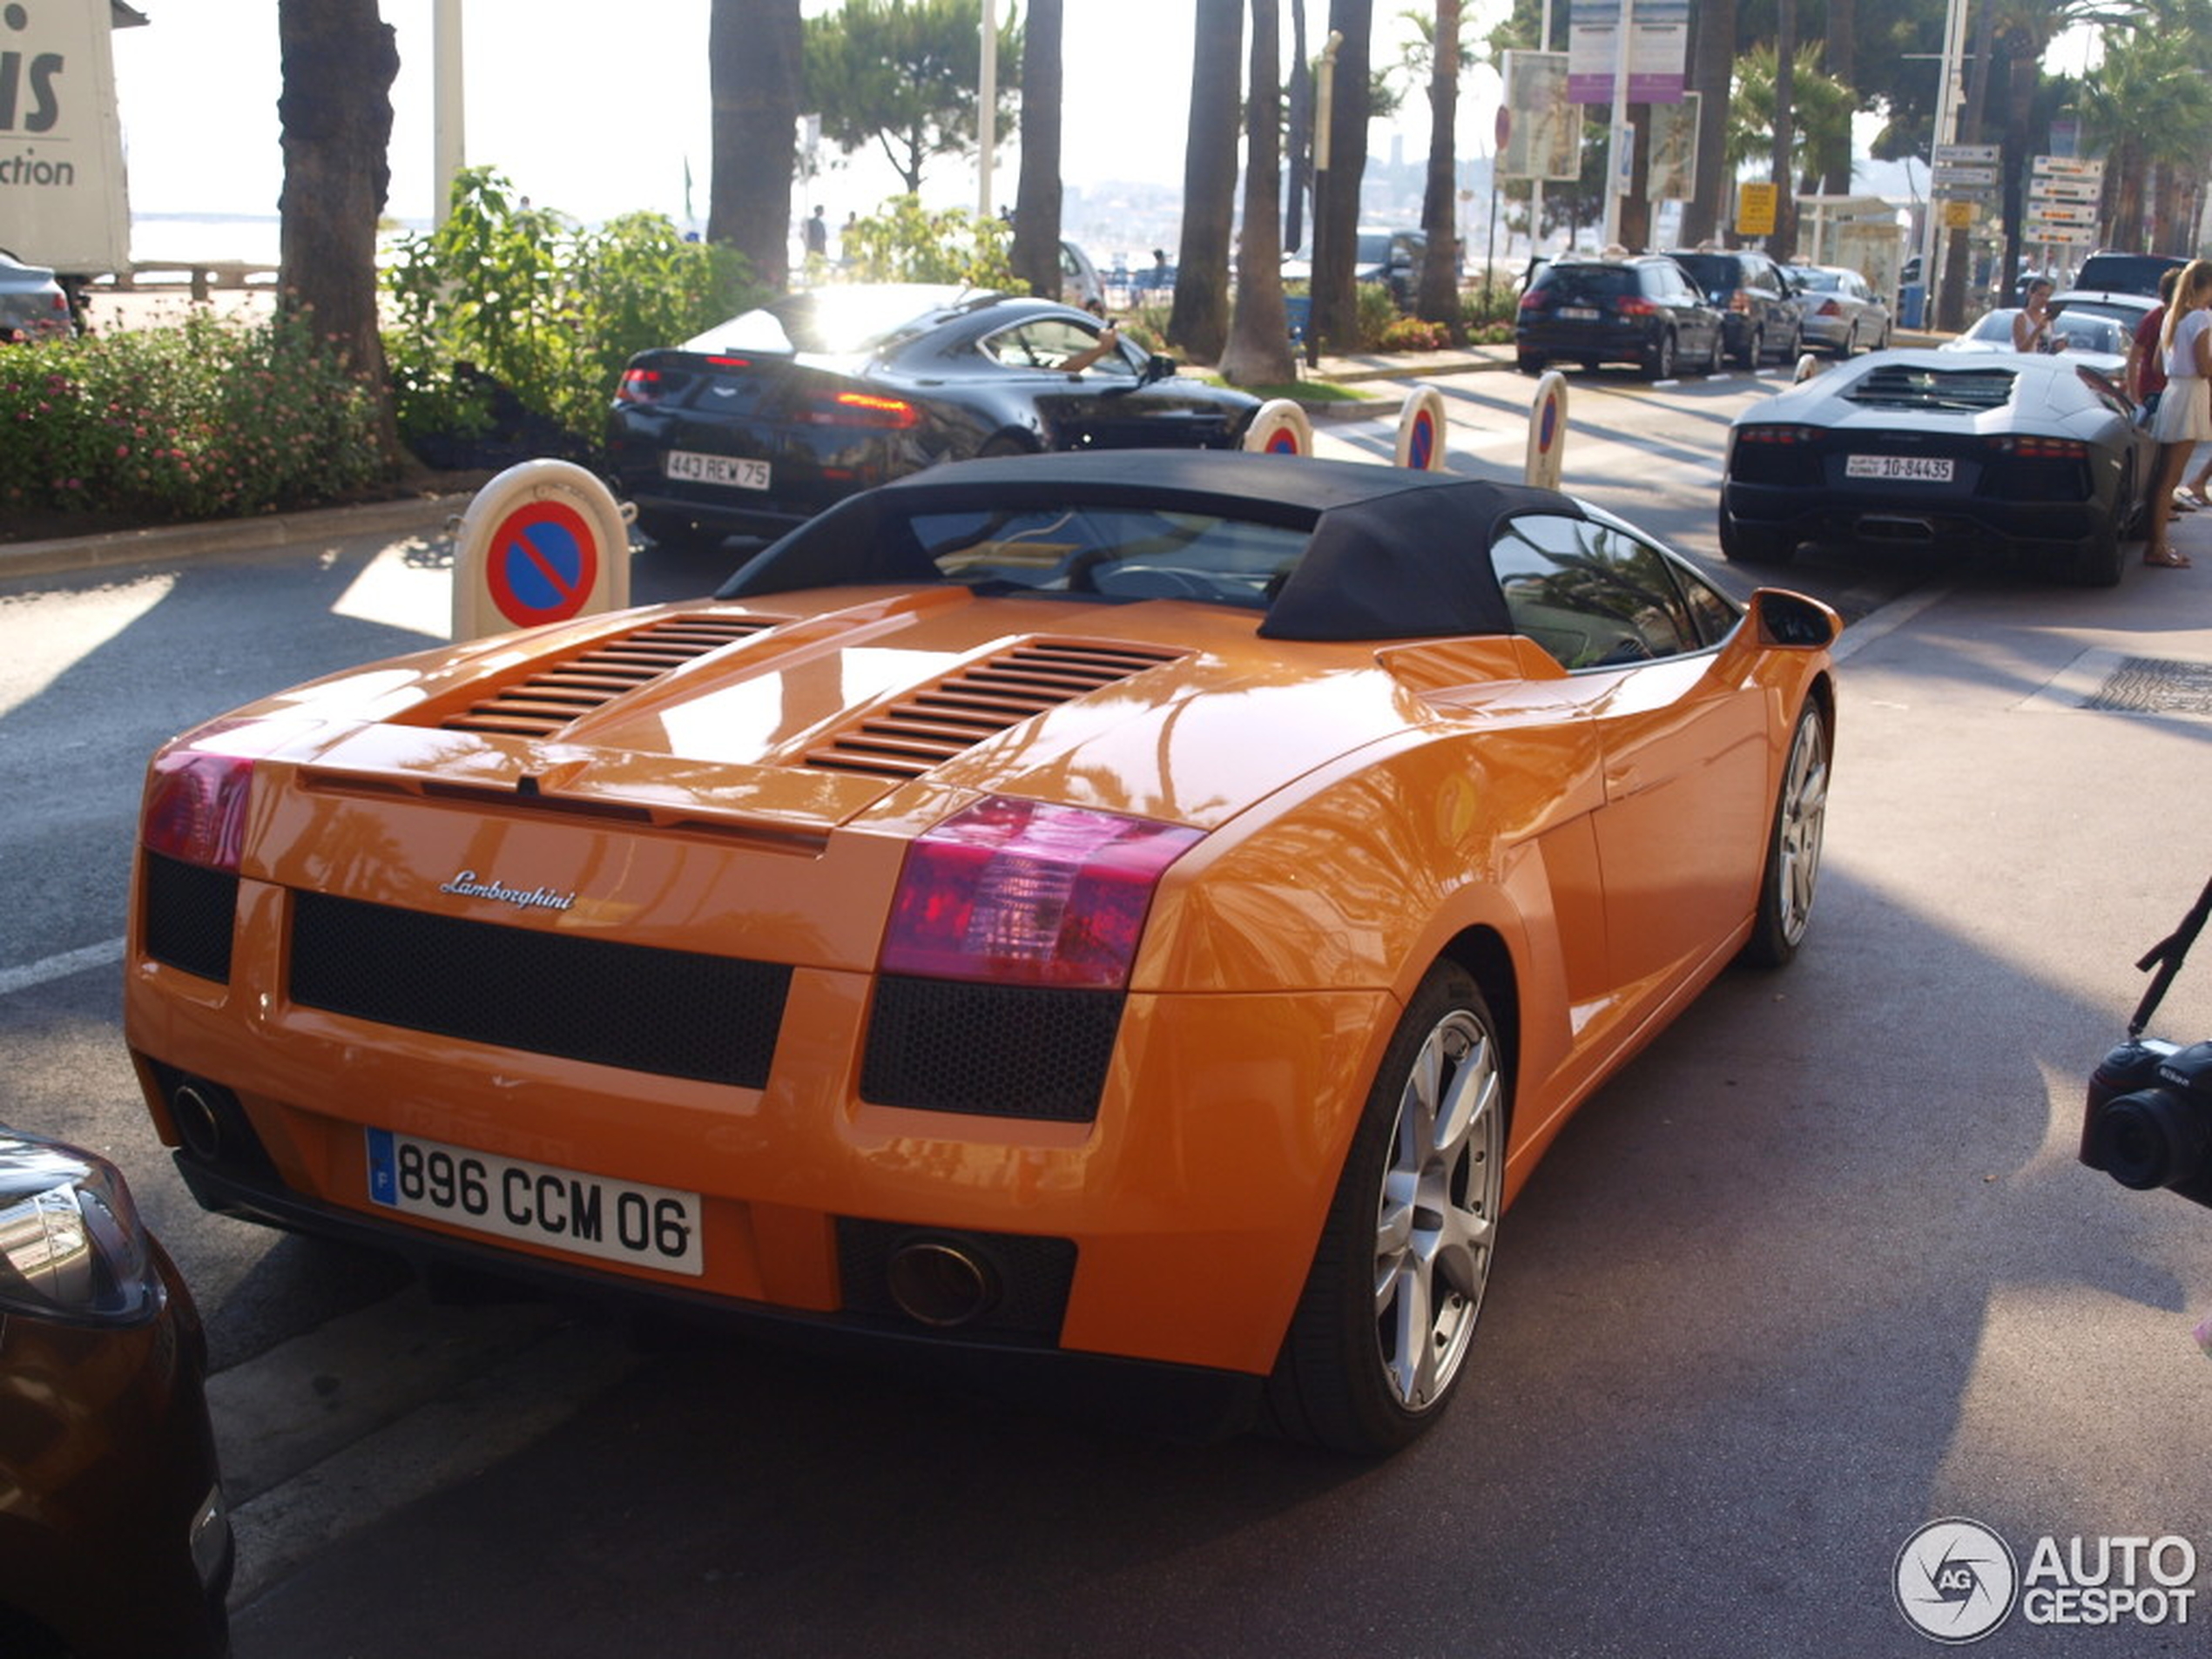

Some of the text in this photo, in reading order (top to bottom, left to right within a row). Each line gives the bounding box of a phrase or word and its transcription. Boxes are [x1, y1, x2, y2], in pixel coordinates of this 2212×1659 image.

[671, 455, 702, 478] 443
[745, 462, 768, 485] 75
[1883, 459, 1950, 478] 10-84435
[439, 869, 576, 910] Lamborghini
[378, 1171, 388, 1188] F
[398, 1143, 689, 1258] 896 CCM 06
